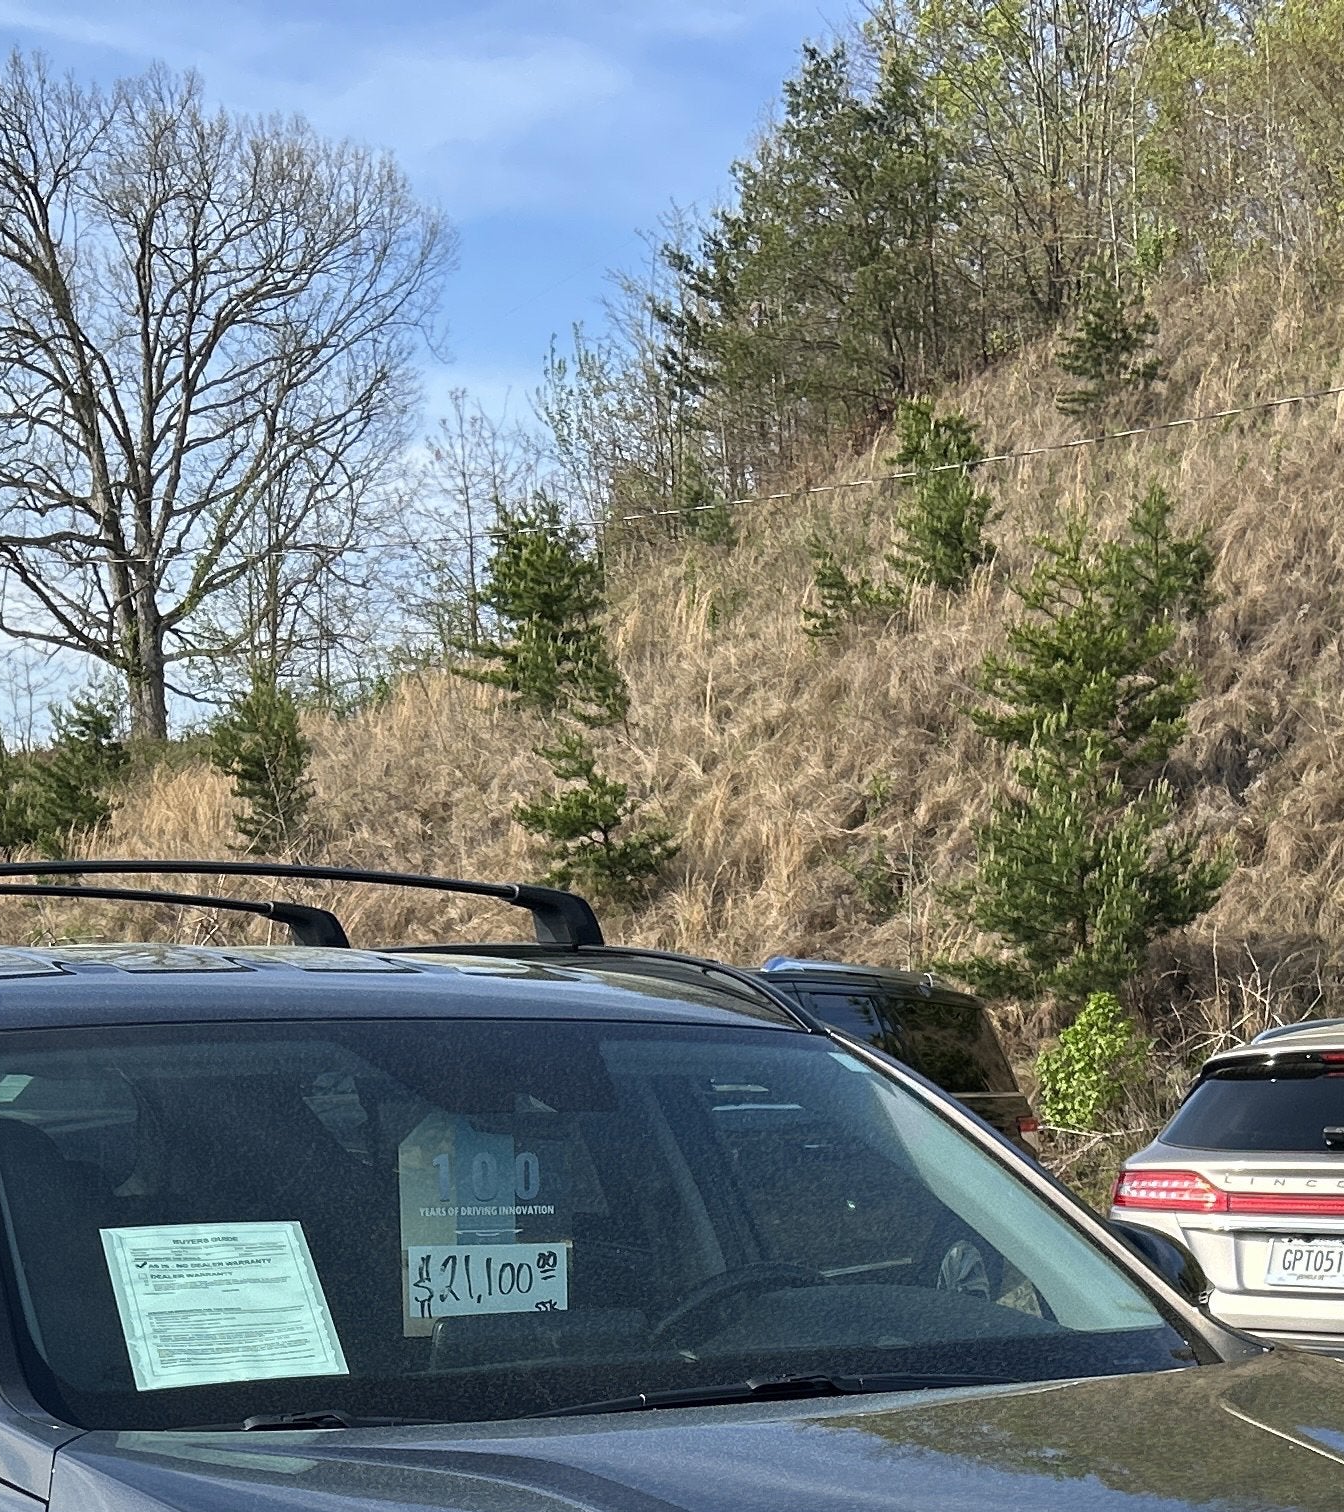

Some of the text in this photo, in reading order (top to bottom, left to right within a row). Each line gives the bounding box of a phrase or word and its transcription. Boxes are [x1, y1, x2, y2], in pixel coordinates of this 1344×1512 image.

[432, 1151, 540, 1202] 100
[419, 1205, 555, 1217] YEARS OF DRIVING INNOVATION
[172, 1237, 209, 1245] BUYERS
[225, 1258, 272, 1267] WARRANTY
[1282, 1249, 1344, 1273] GPT051
